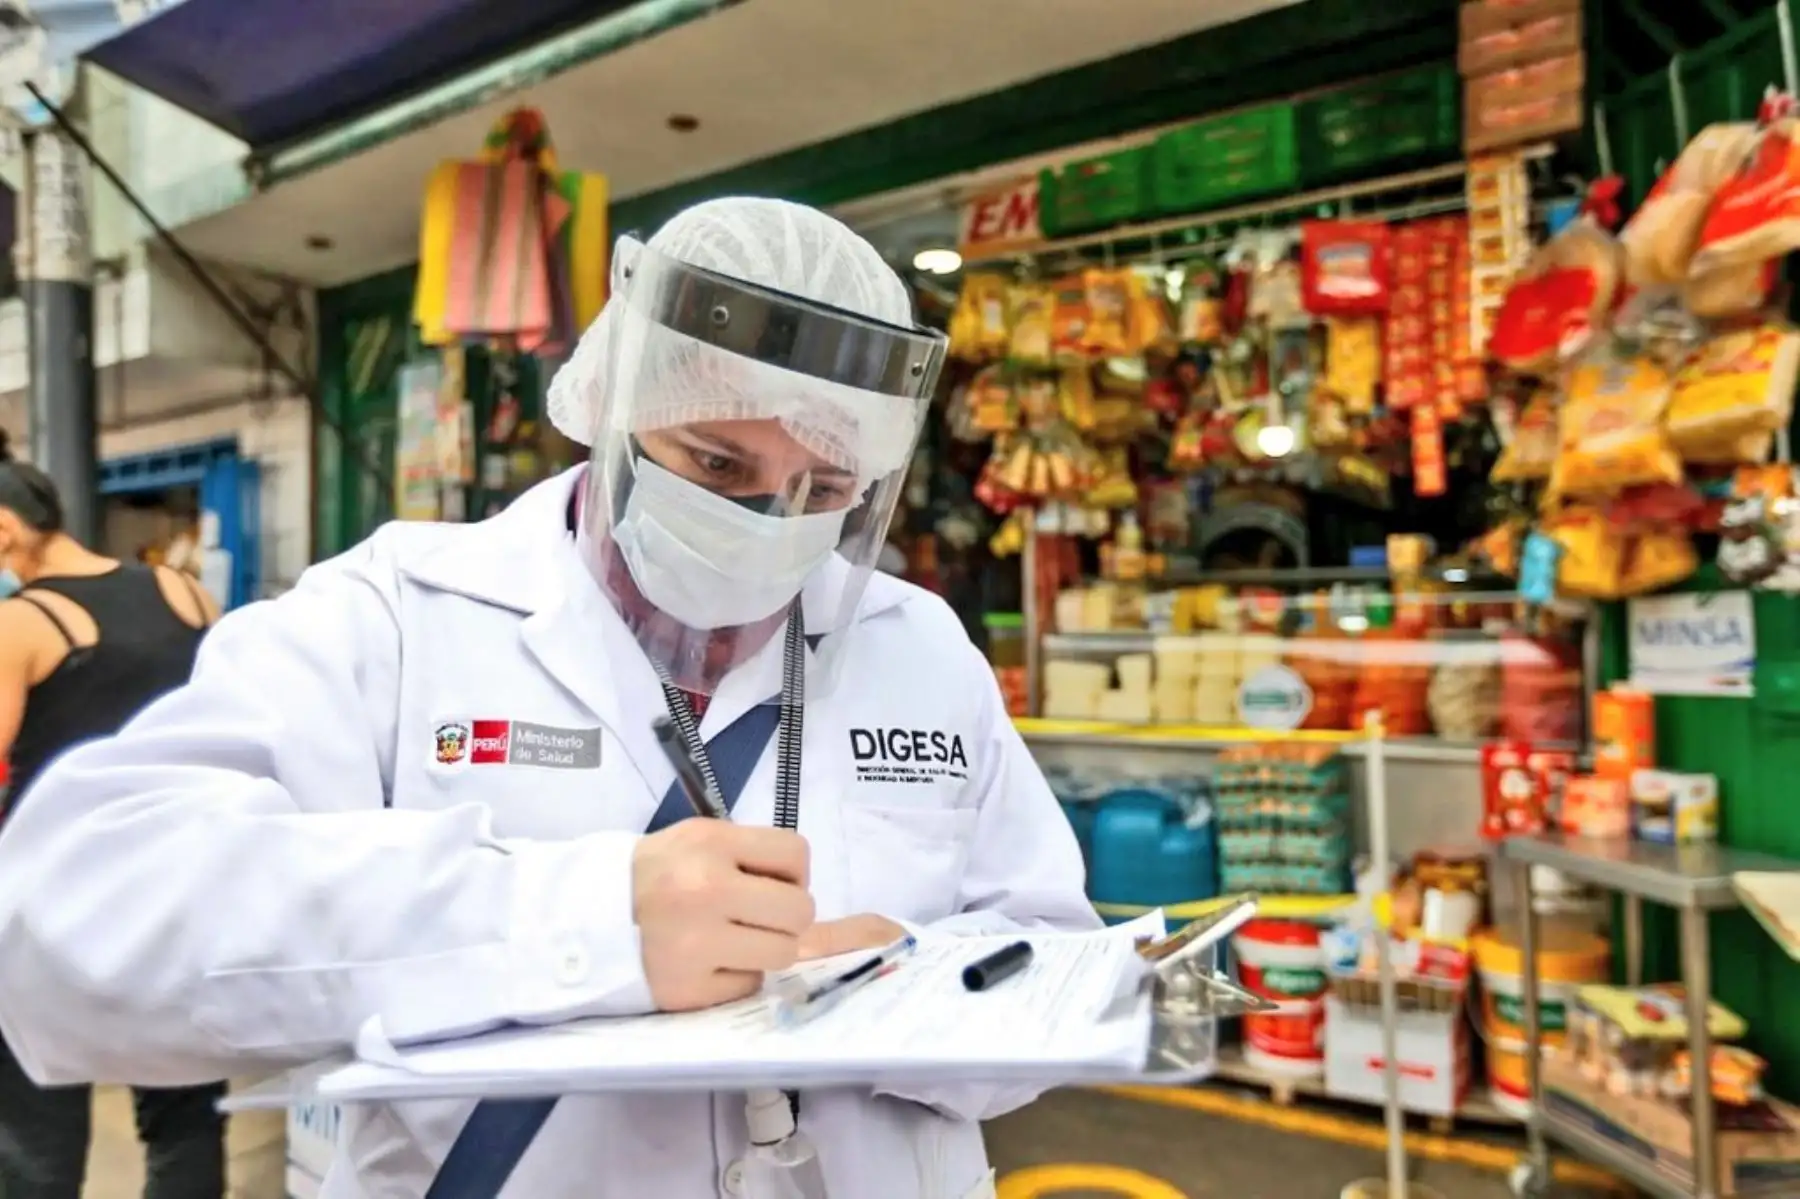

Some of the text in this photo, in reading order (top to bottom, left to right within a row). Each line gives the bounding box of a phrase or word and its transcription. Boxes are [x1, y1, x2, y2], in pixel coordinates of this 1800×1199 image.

[1636, 616, 1744, 648] MINSA
[472, 732, 508, 752] PERÚ
[516, 729, 584, 749] Ministerio
[850, 728, 968, 768] DIGESA
[516, 747, 575, 765] de Salud
